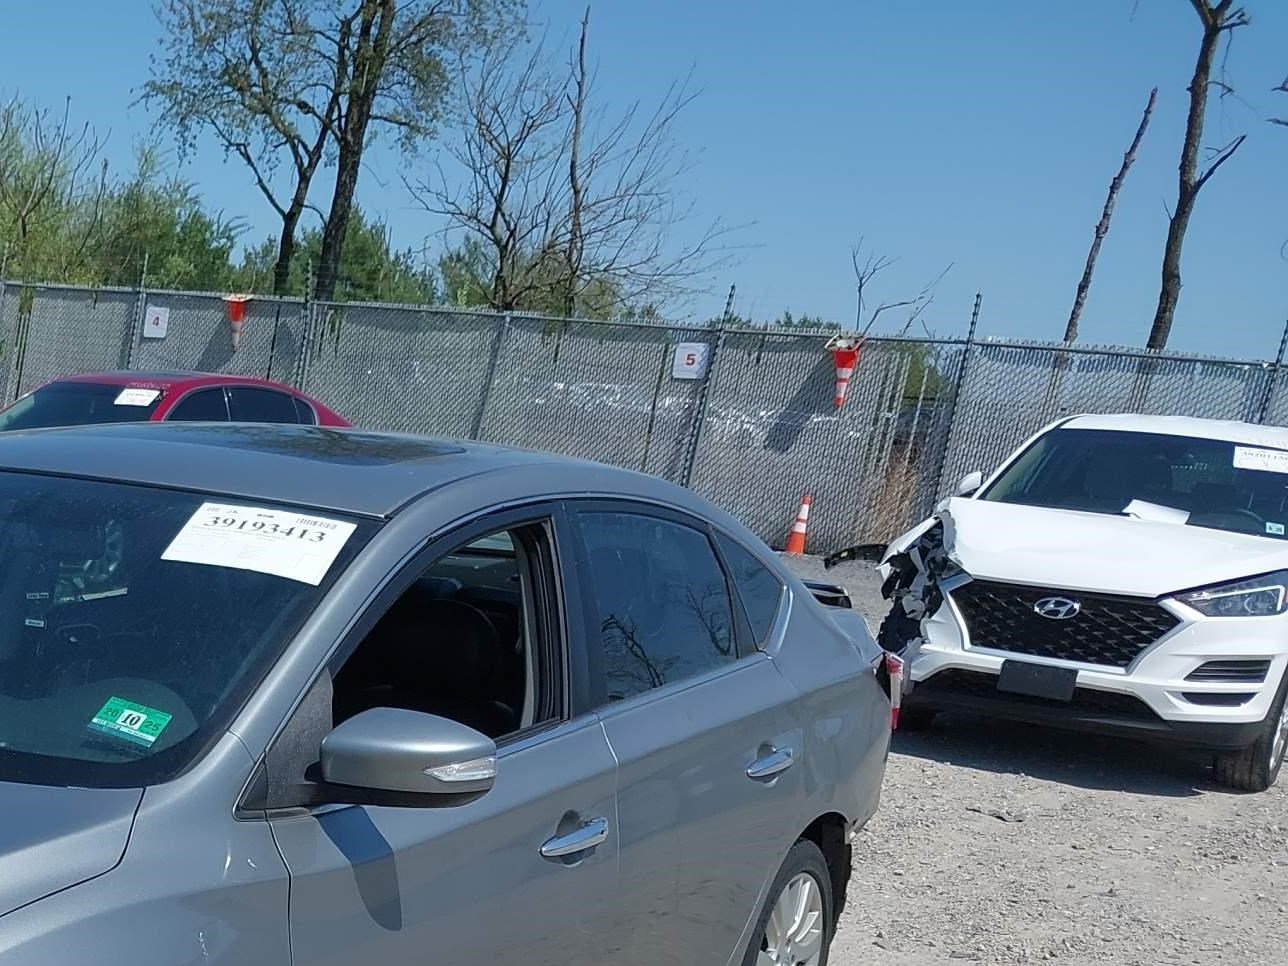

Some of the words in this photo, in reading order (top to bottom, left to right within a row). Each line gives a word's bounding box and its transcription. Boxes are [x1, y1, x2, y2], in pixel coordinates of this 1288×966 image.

[152, 316, 160, 327] 4
[686, 353, 697, 366] 5
[203, 516, 327, 543] 39193413
[103, 707, 119, 718] 20
[120, 713, 142, 726] 10
[142, 720, 162, 732] 25
